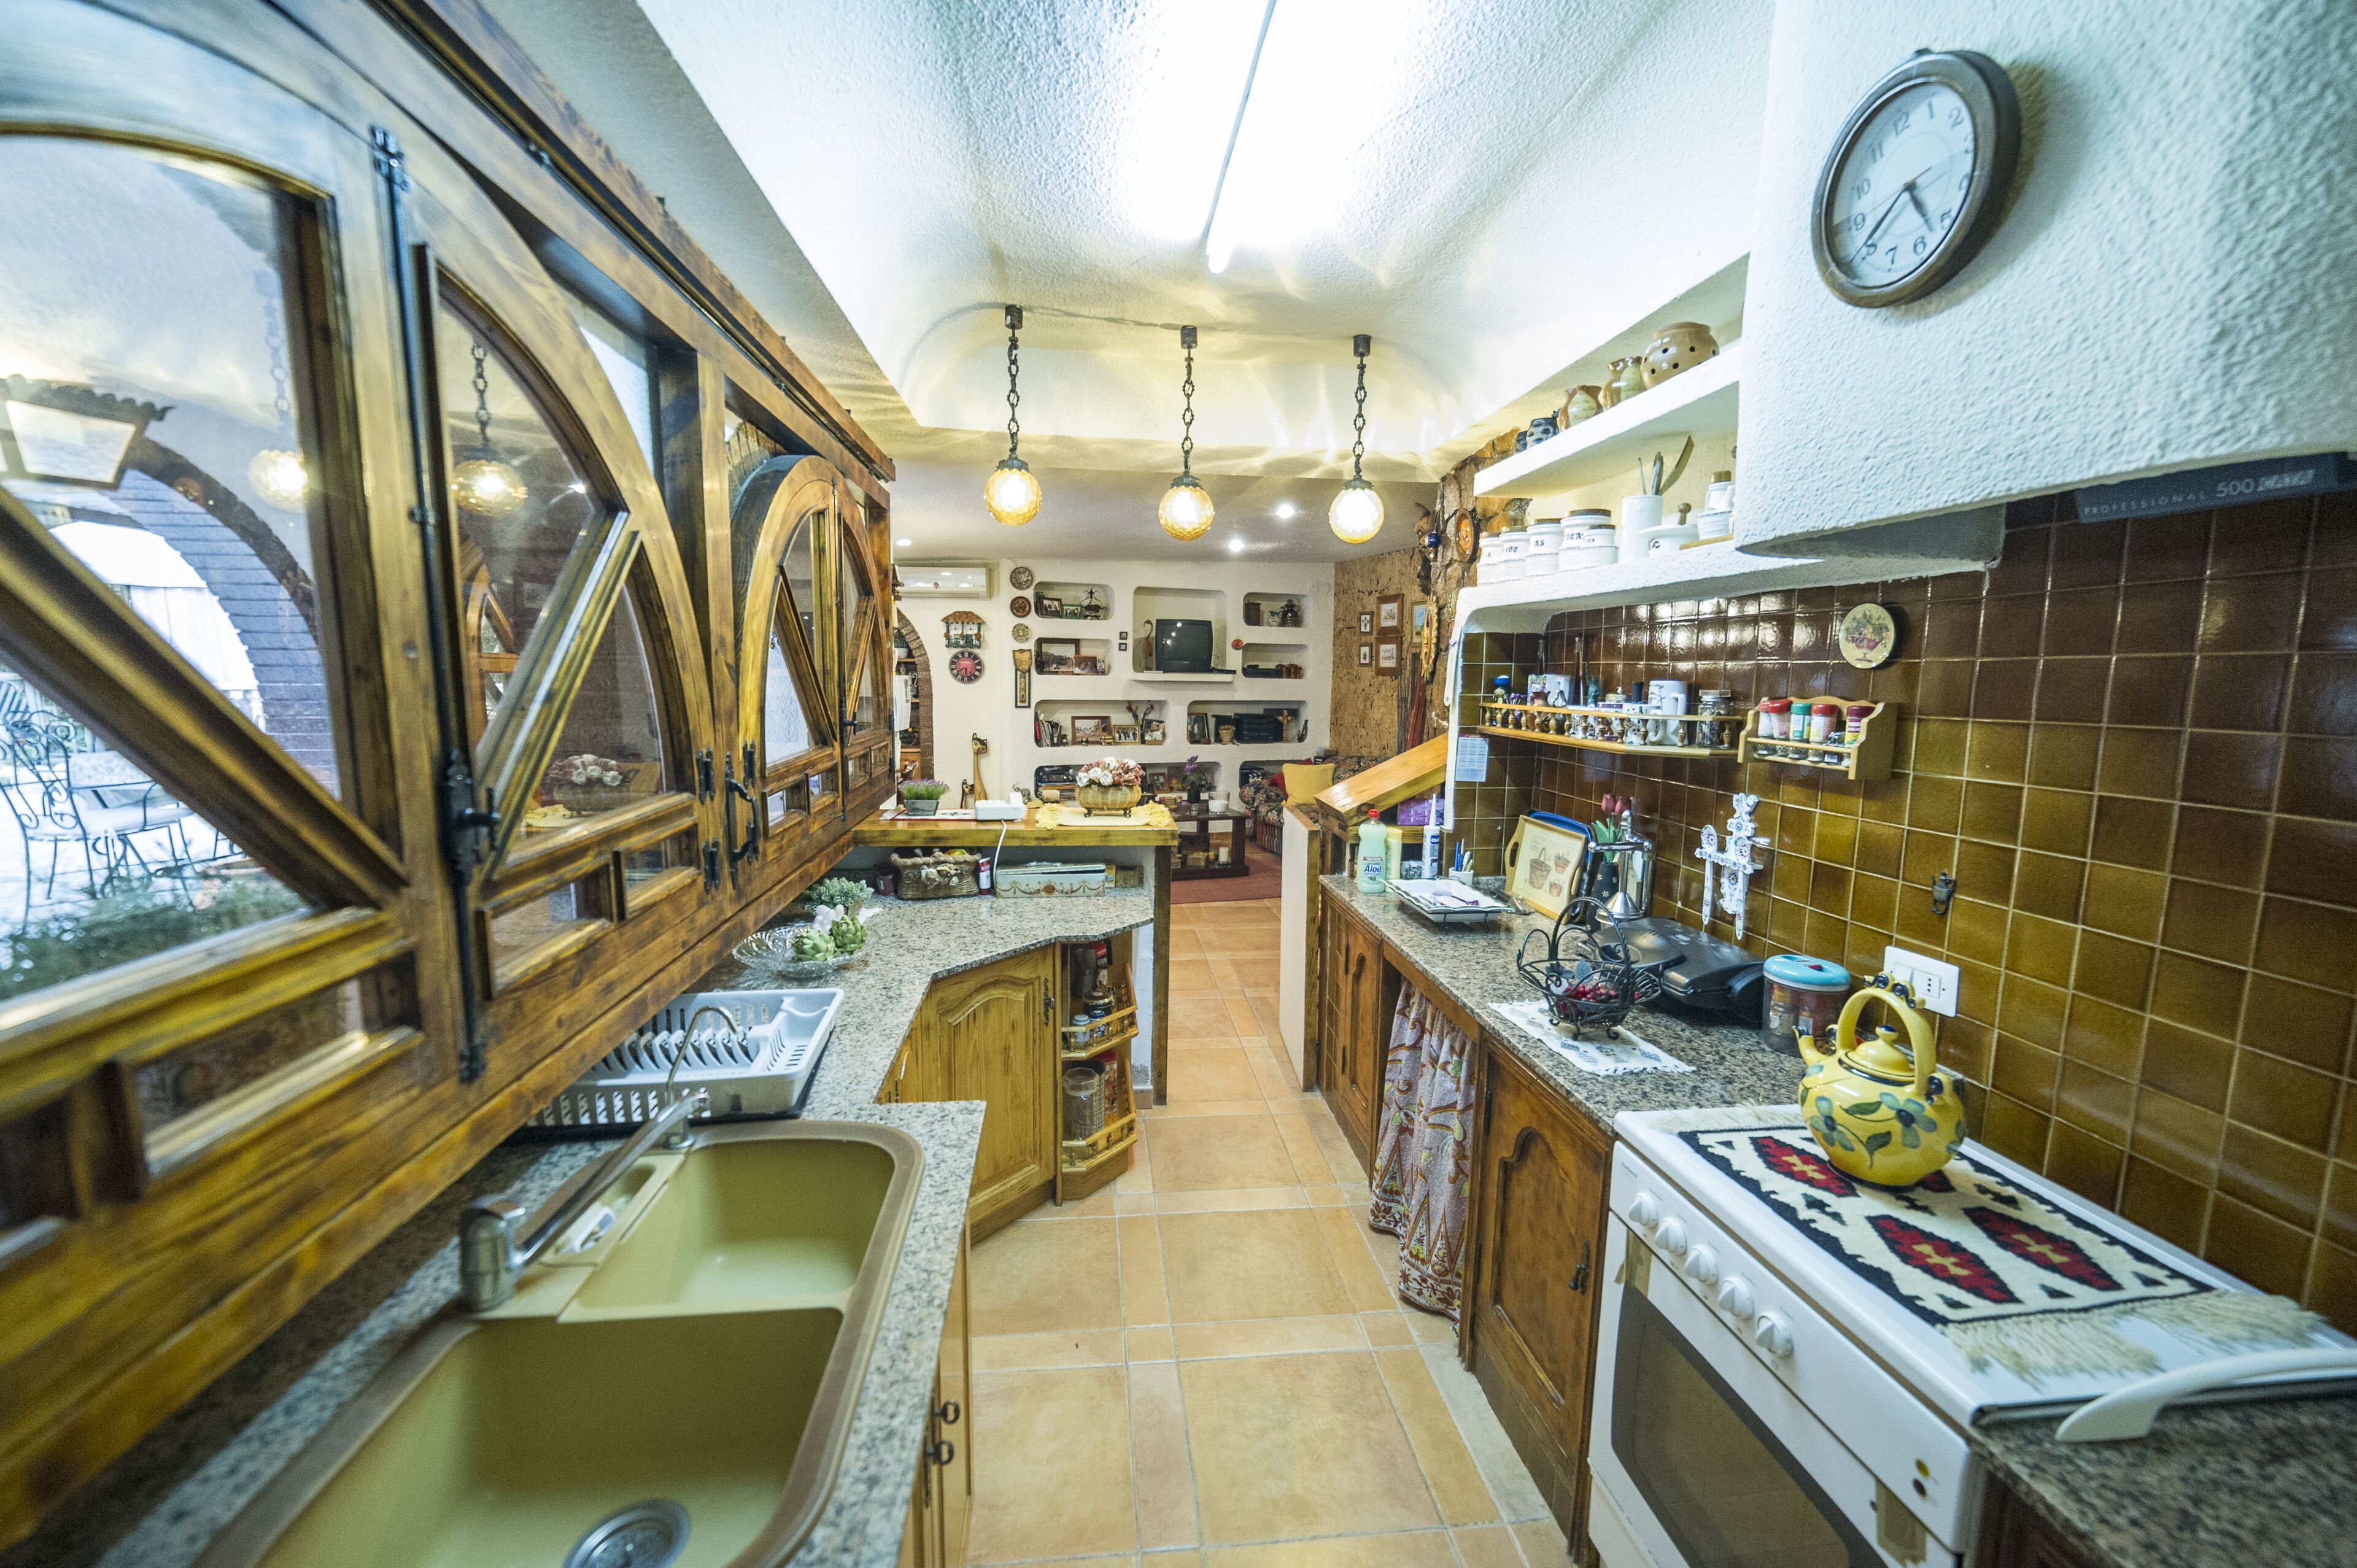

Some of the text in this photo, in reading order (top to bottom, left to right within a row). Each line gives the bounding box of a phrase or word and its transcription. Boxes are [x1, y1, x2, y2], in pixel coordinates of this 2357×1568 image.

[1927, 101, 1935, 119] 1
[1949, 107, 1965, 129] 2
[1893, 111, 1911, 137] 12
[1870, 141, 1885, 163] 11
[1855, 177, 1871, 201] 10
[1853, 212, 1867, 232] 9
[1940, 209, 1953, 230] 5
[1864, 241, 1878, 257] 8
[1885, 245, 1898, 265] 7
[1913, 236, 1927, 257] 6
[2216, 478, 2254, 497] 500
